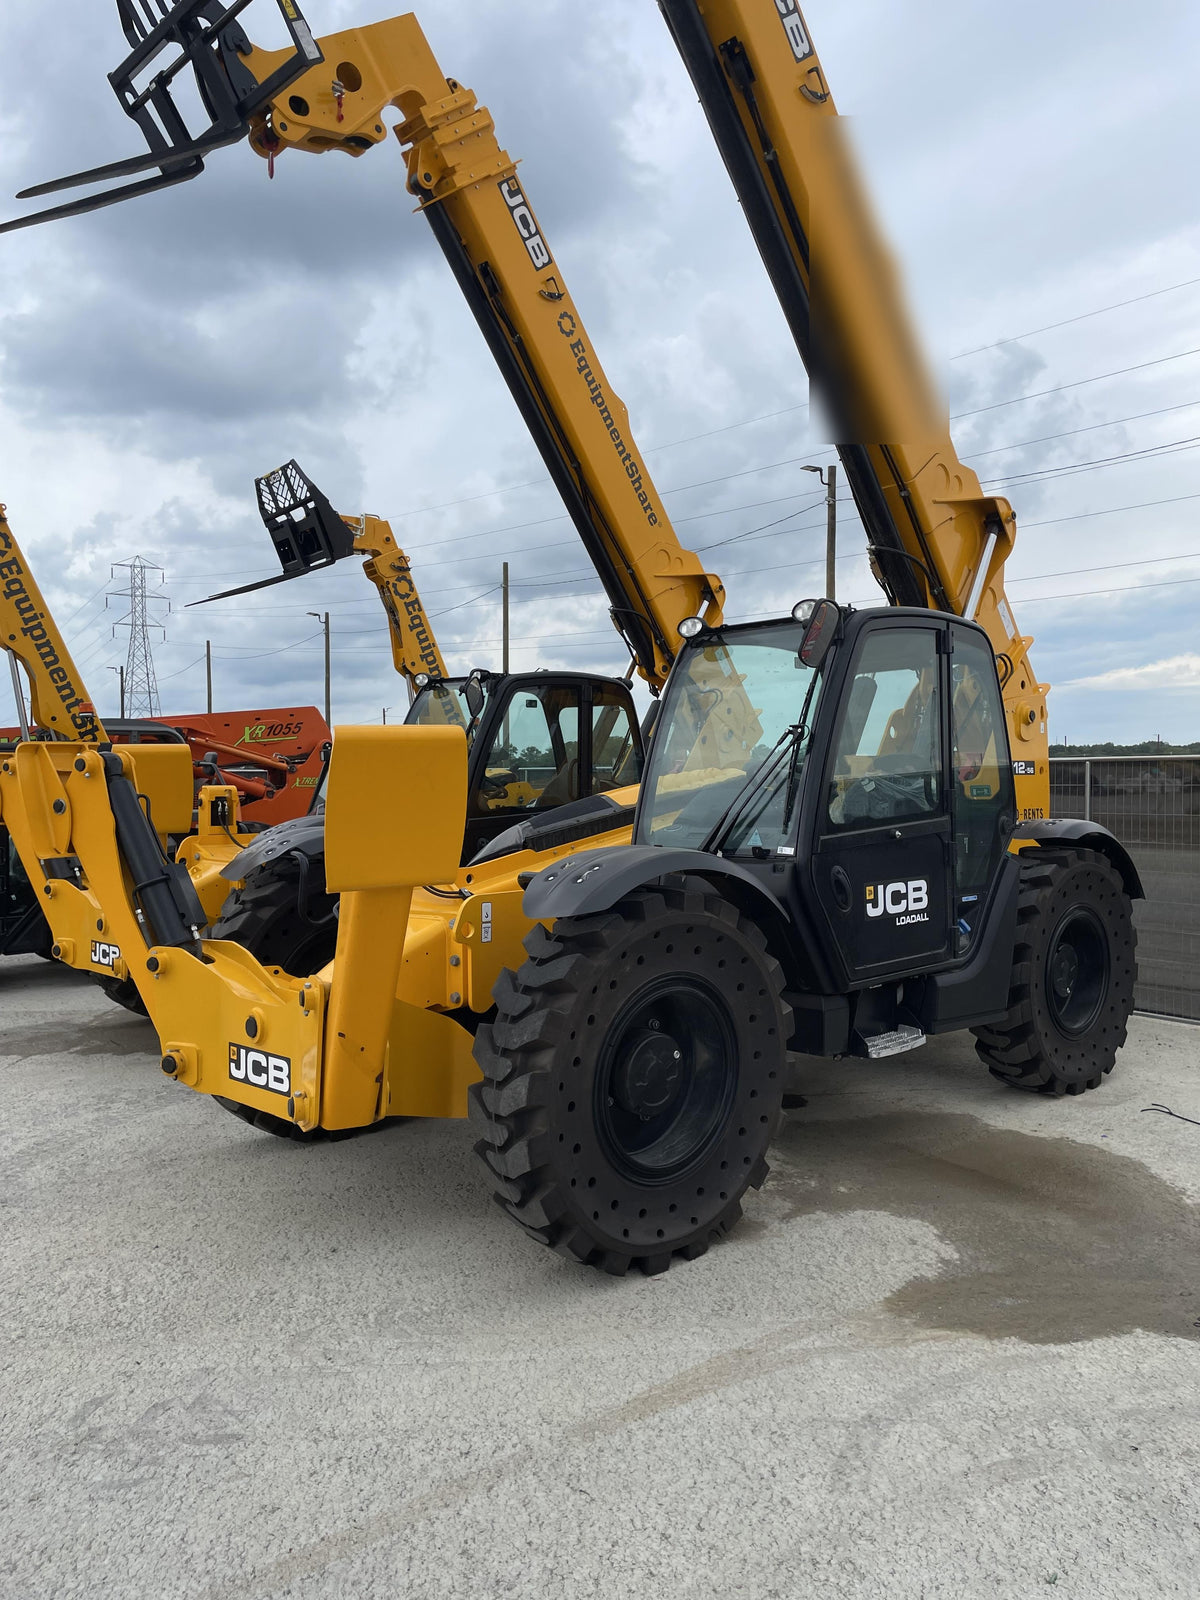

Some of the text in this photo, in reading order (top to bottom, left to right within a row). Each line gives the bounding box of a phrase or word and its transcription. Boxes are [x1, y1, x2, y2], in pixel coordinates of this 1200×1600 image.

[500, 179, 550, 269] JCB
[569, 338, 659, 527] EquipmentShare
[1012, 761, 1035, 774] 12-56
[866, 879, 929, 917] JCB
[895, 912, 930, 926] LOADALL
[230, 1048, 290, 1093] JCB
